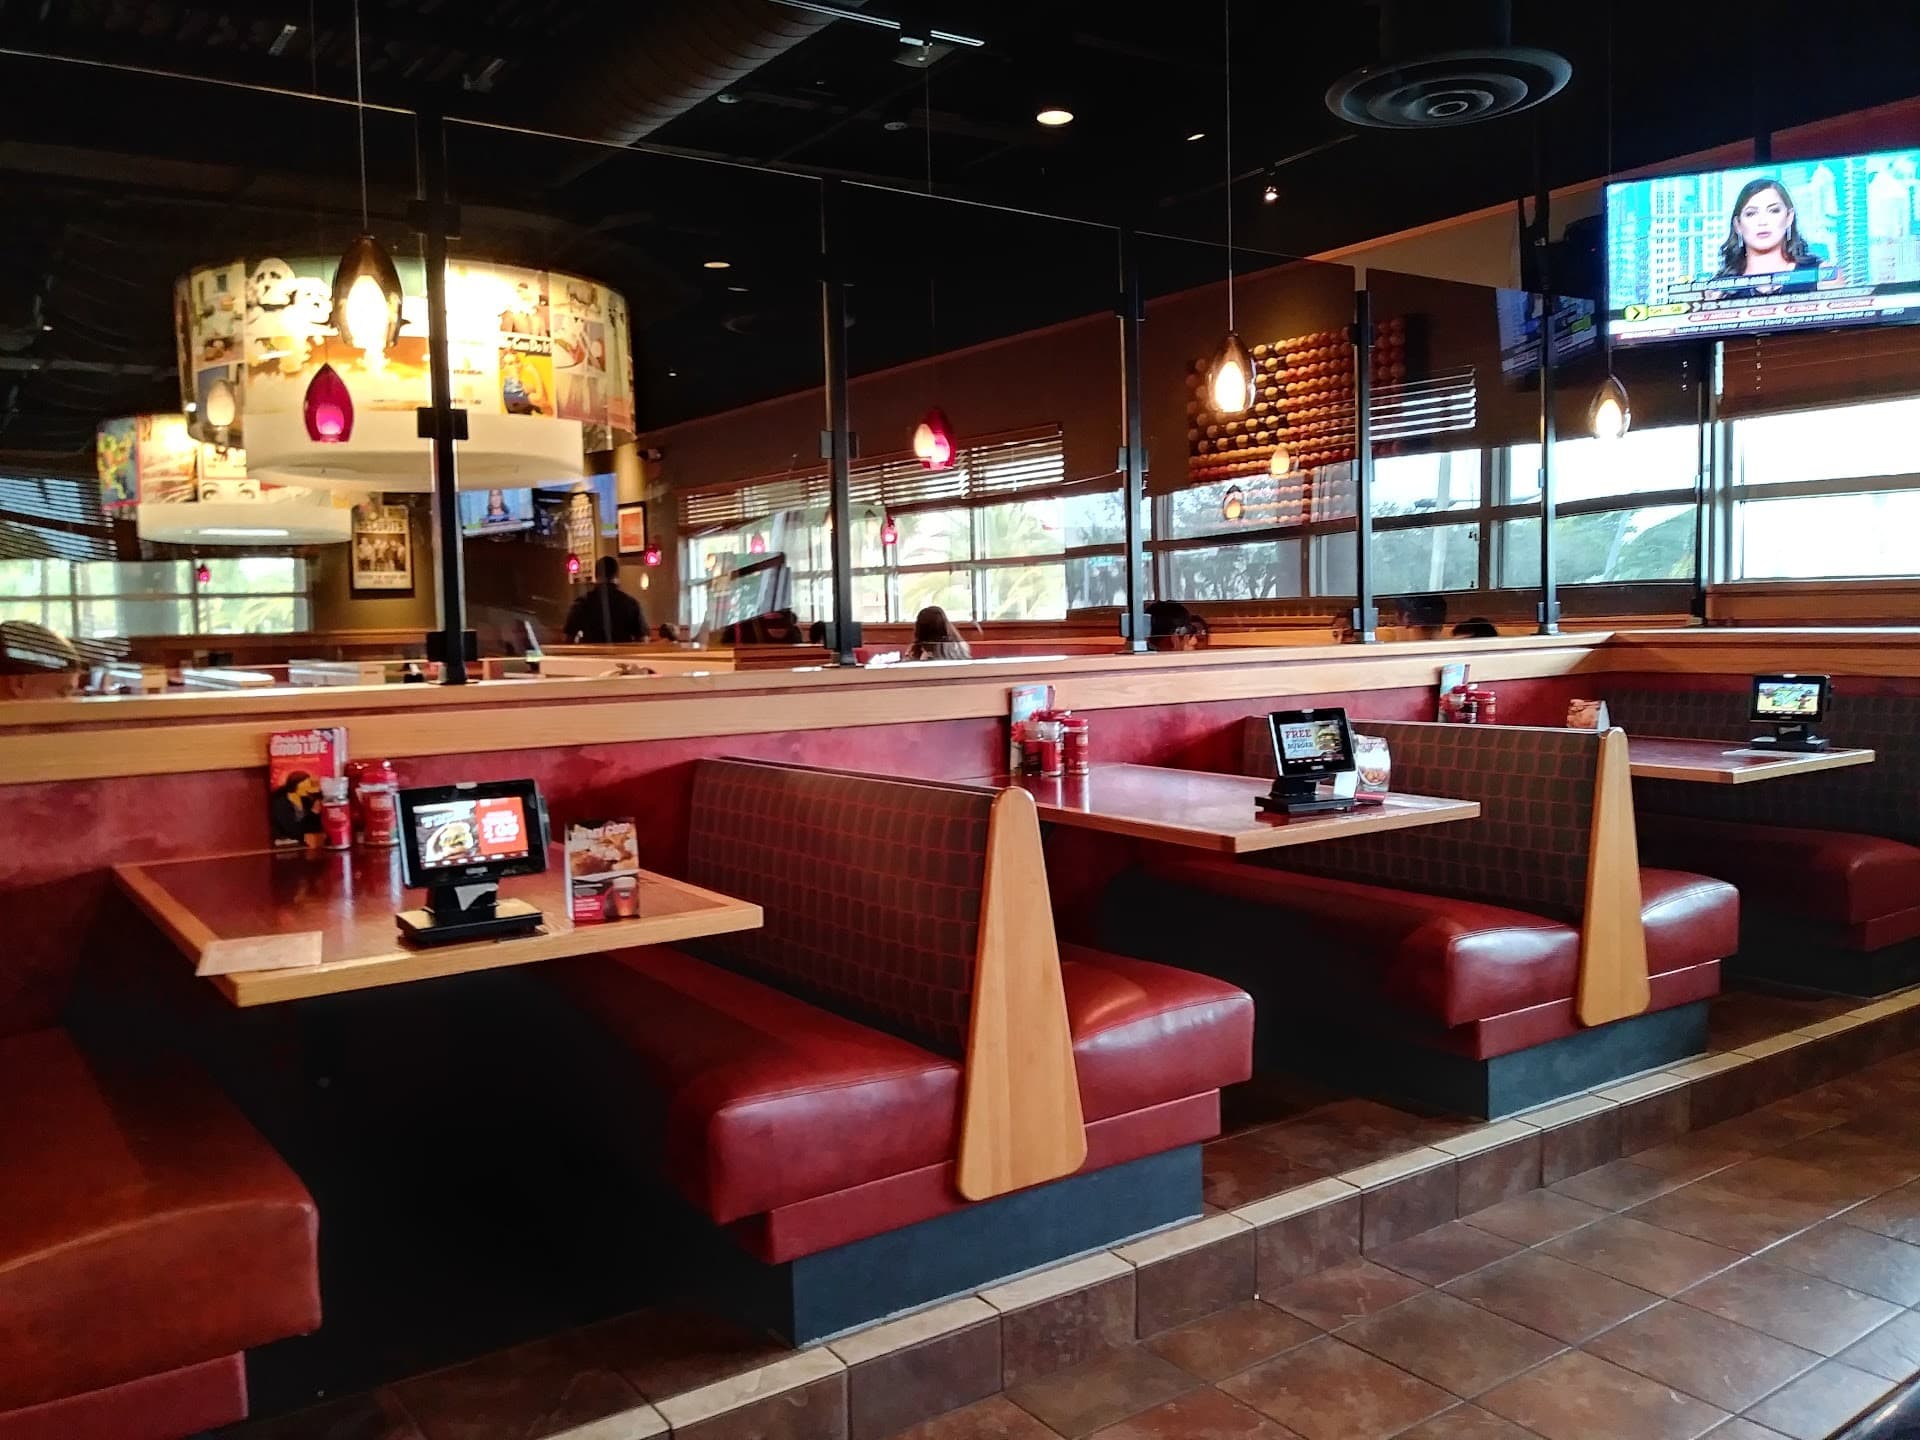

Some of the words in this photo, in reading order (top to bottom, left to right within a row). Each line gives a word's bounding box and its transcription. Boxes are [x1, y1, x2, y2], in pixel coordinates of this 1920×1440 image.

[1285, 729, 1312, 739] FREE
[270, 743, 302, 756] GOOD
[303, 741, 329, 755] LIFE
